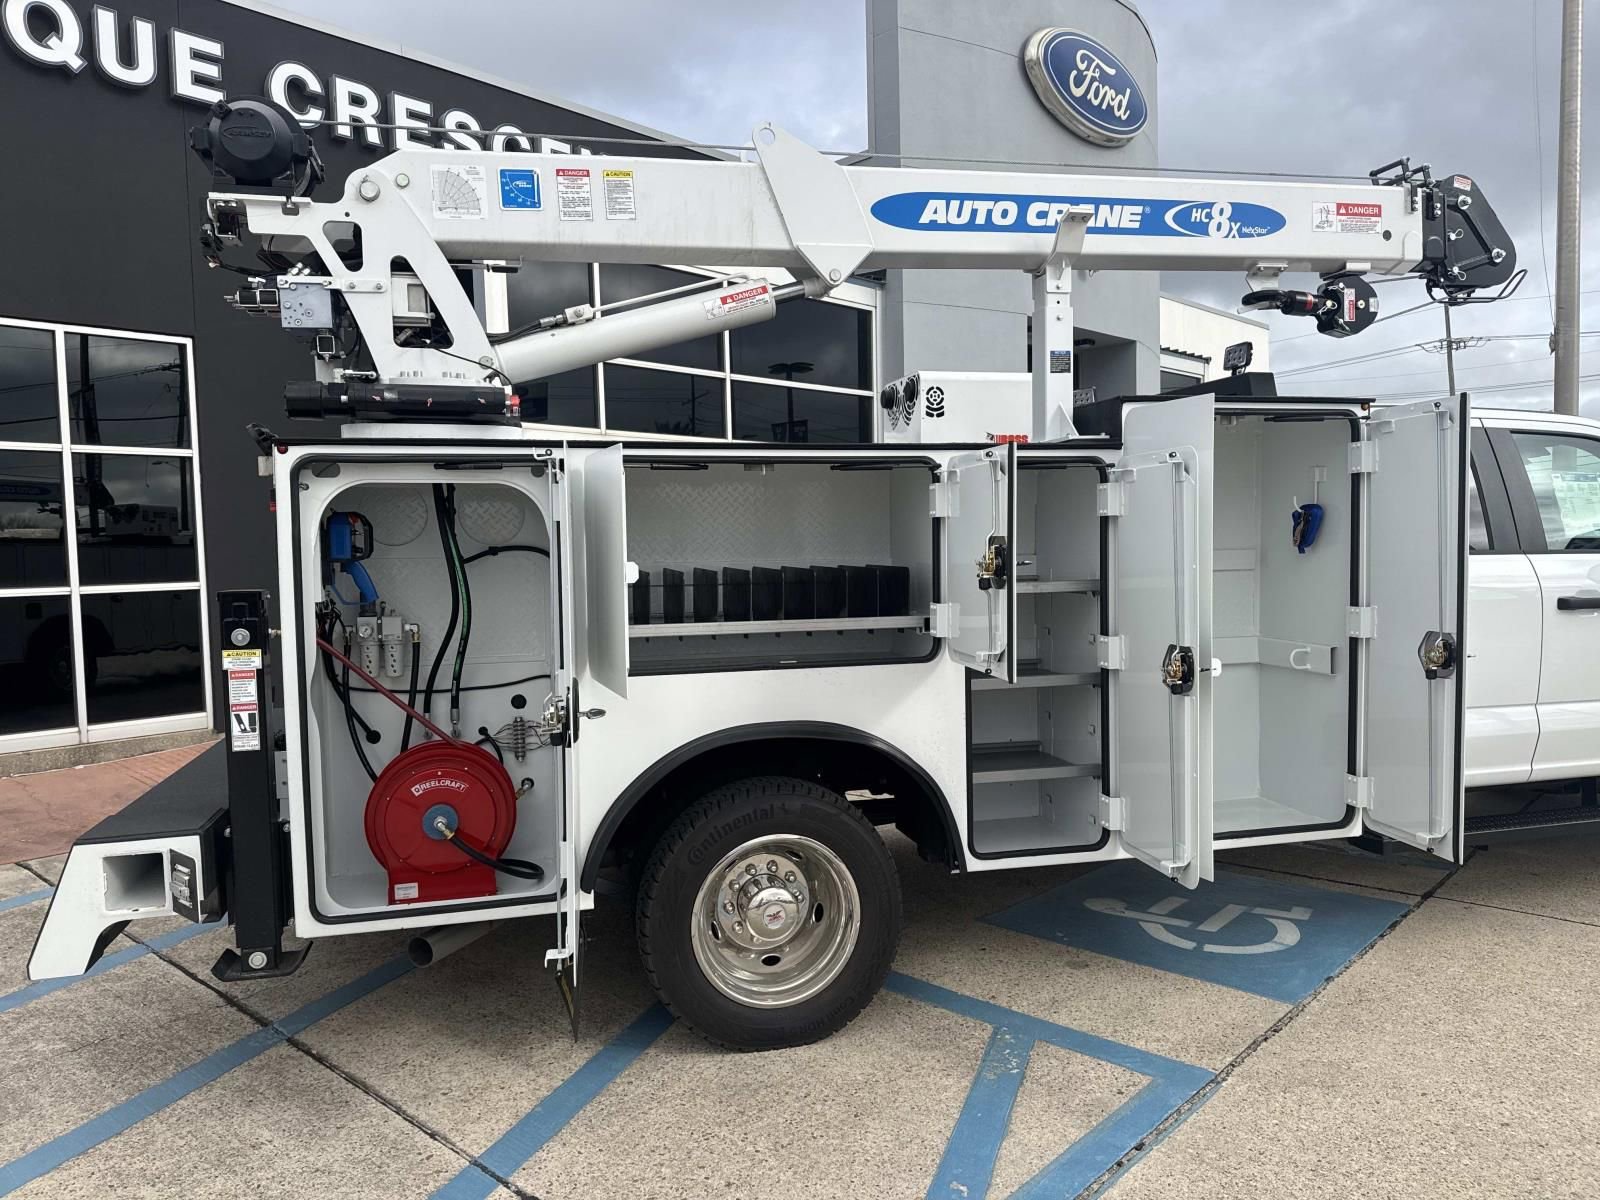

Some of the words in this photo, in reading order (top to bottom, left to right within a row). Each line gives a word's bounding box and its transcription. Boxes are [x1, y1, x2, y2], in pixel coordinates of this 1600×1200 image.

[2, 0, 226, 104] QUE
[265, 60, 607, 155] CRESC
[1069, 49, 1131, 121] Ford
[918, 199, 1018, 226] AUTO
[1348, 206, 1379, 215] DANGER
[733, 288, 764, 301] DANGER
[421, 779, 466, 791] REELCRAFT
[688, 803, 774, 865] Continental
